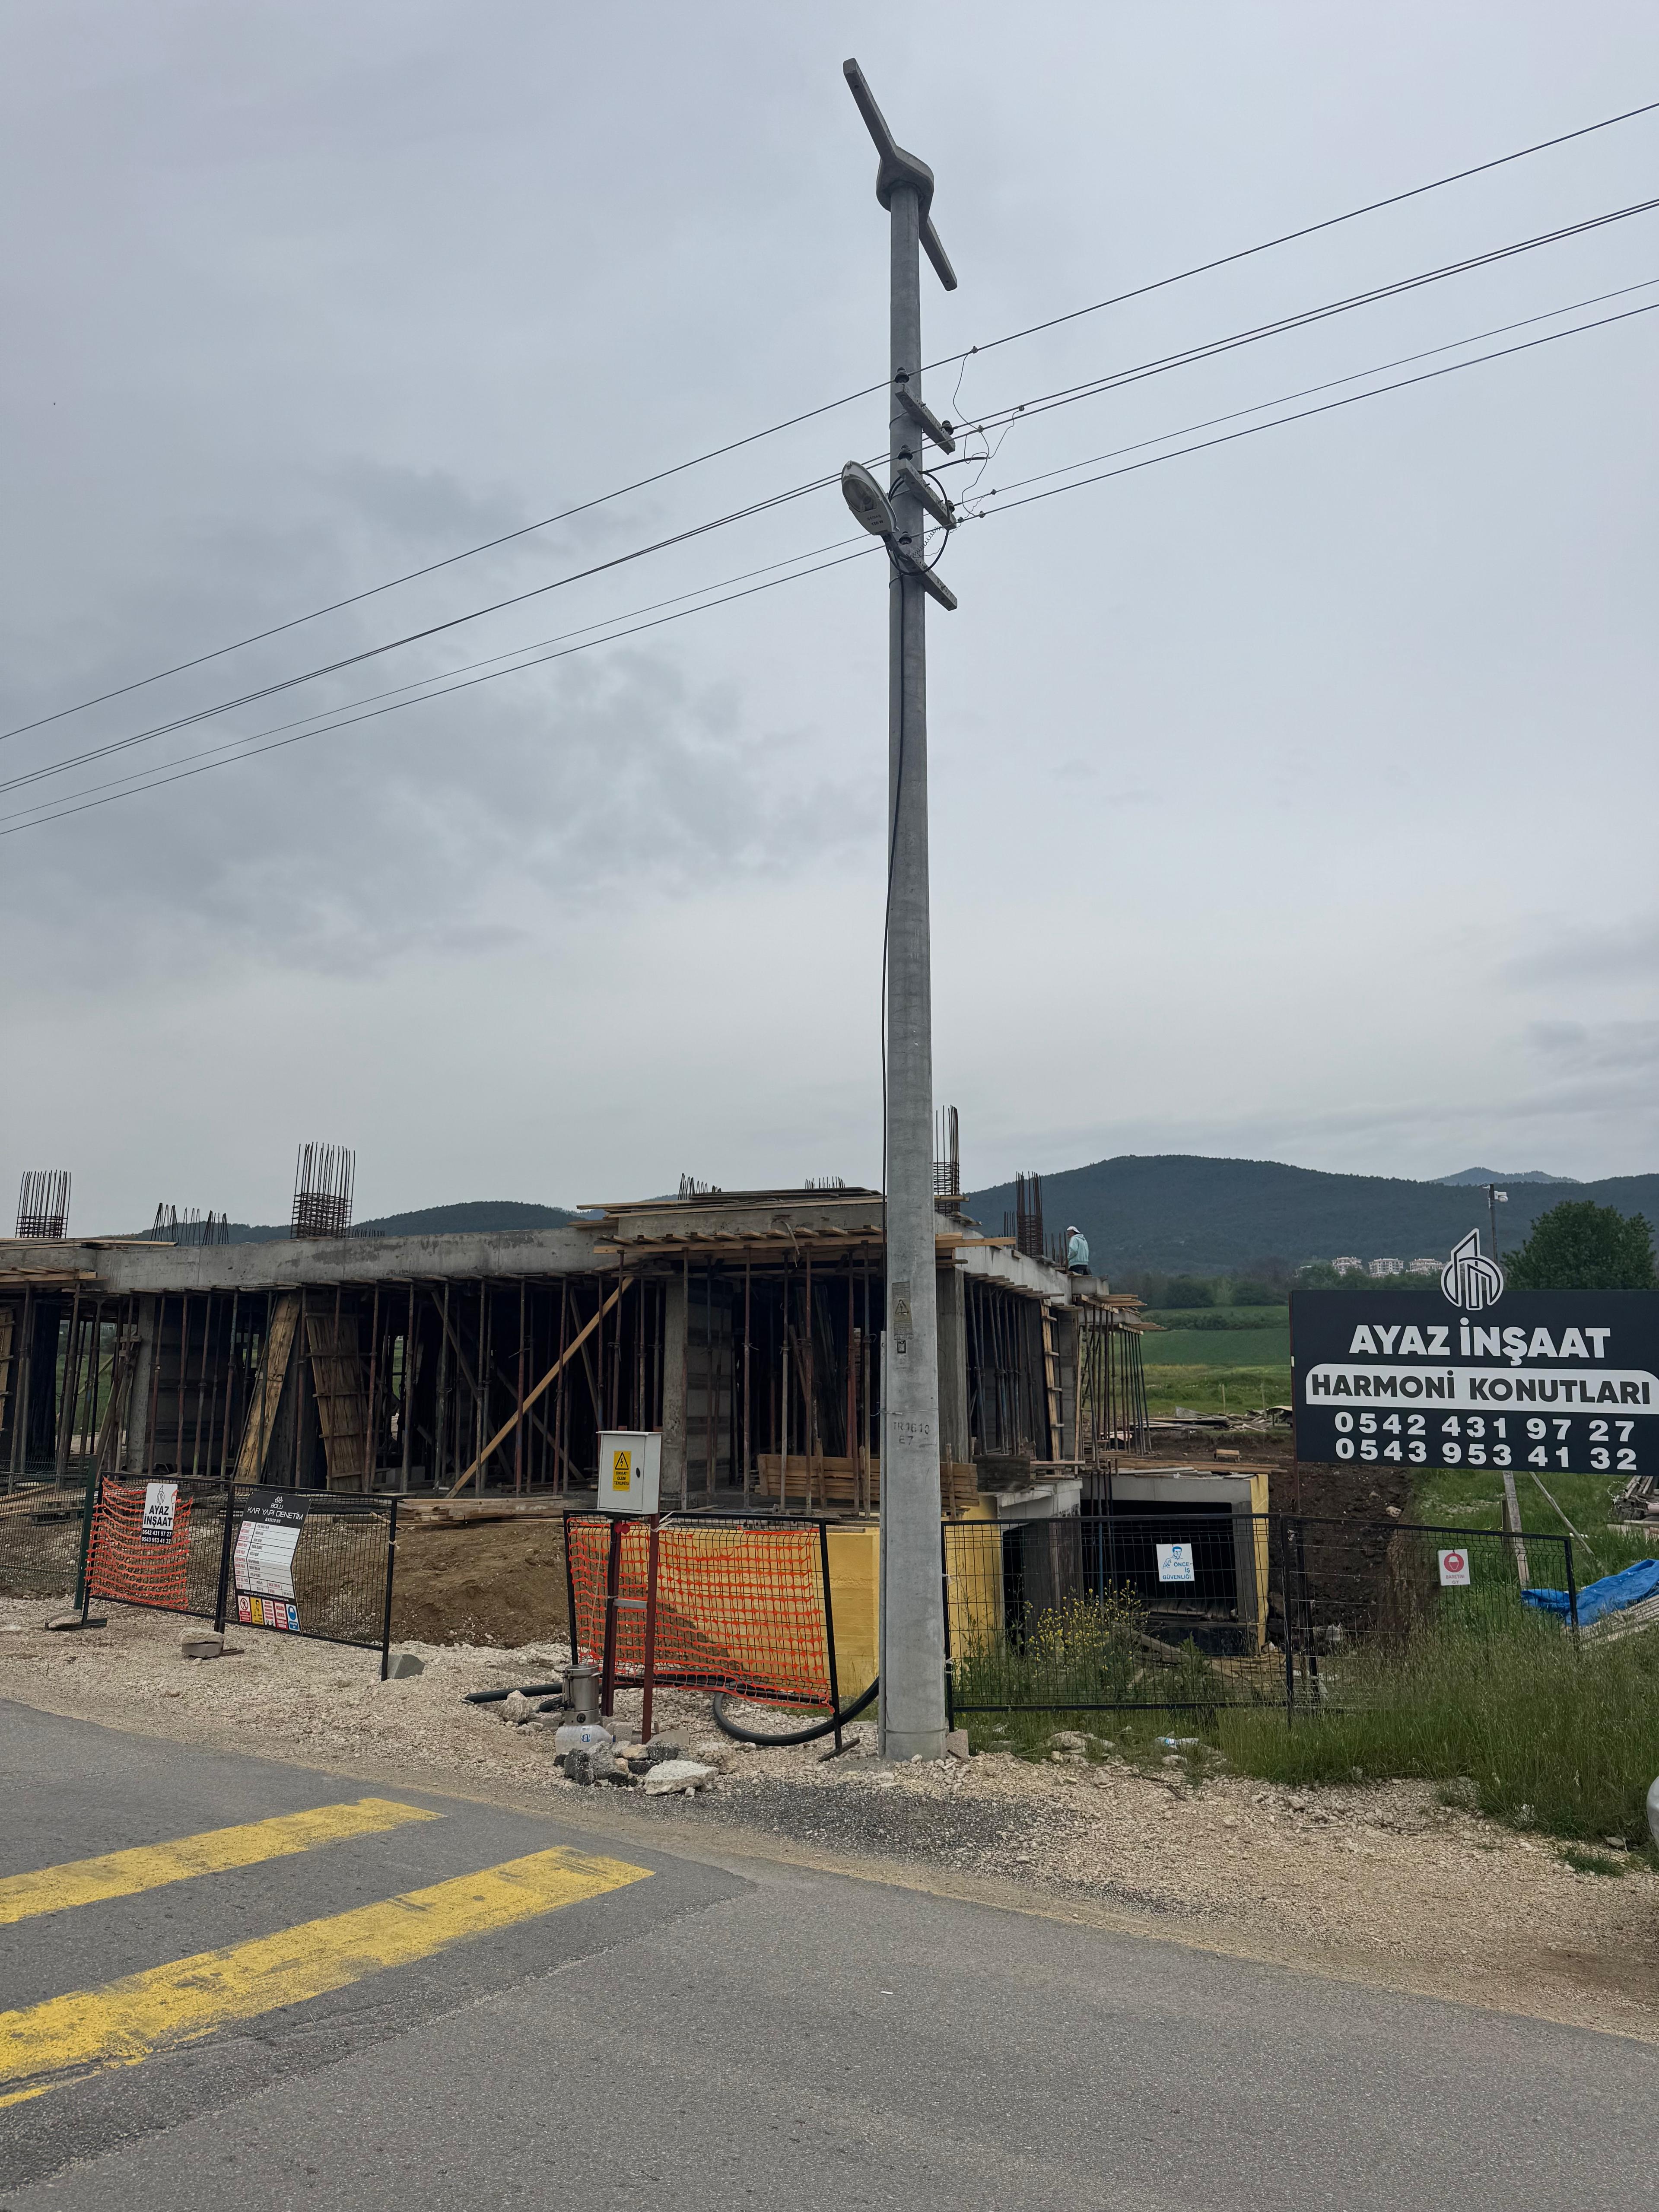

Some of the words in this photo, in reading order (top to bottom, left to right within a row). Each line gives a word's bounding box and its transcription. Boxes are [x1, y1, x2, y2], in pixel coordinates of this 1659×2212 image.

[1349, 1325, 1450, 1356] AYAZ
[1460, 1317, 1611, 1366] İNŞAAT
[1312, 1370, 1455, 1399] HARMONİ
[1469, 1378, 1650, 1405] KONUTLARI
[1335, 1411, 1426, 1435] 0542
[1441, 1416, 1506, 1438] 431
[1526, 1417, 1572, 1440] 97
[1589, 1420, 1634, 1442] 27
[1335, 1438, 1427, 1462] 0543
[1442, 1442, 1512, 1466] 953
[1528, 1446, 1569, 1468] 41
[1590, 1447, 1637, 1470] 32
[144, 1513, 173, 1528] İNŞAAT
[149, 1505, 169, 1515] AYAZ
[262, 1508, 275, 1516] YAPI
[276, 1512, 304, 1520] DENETİM
